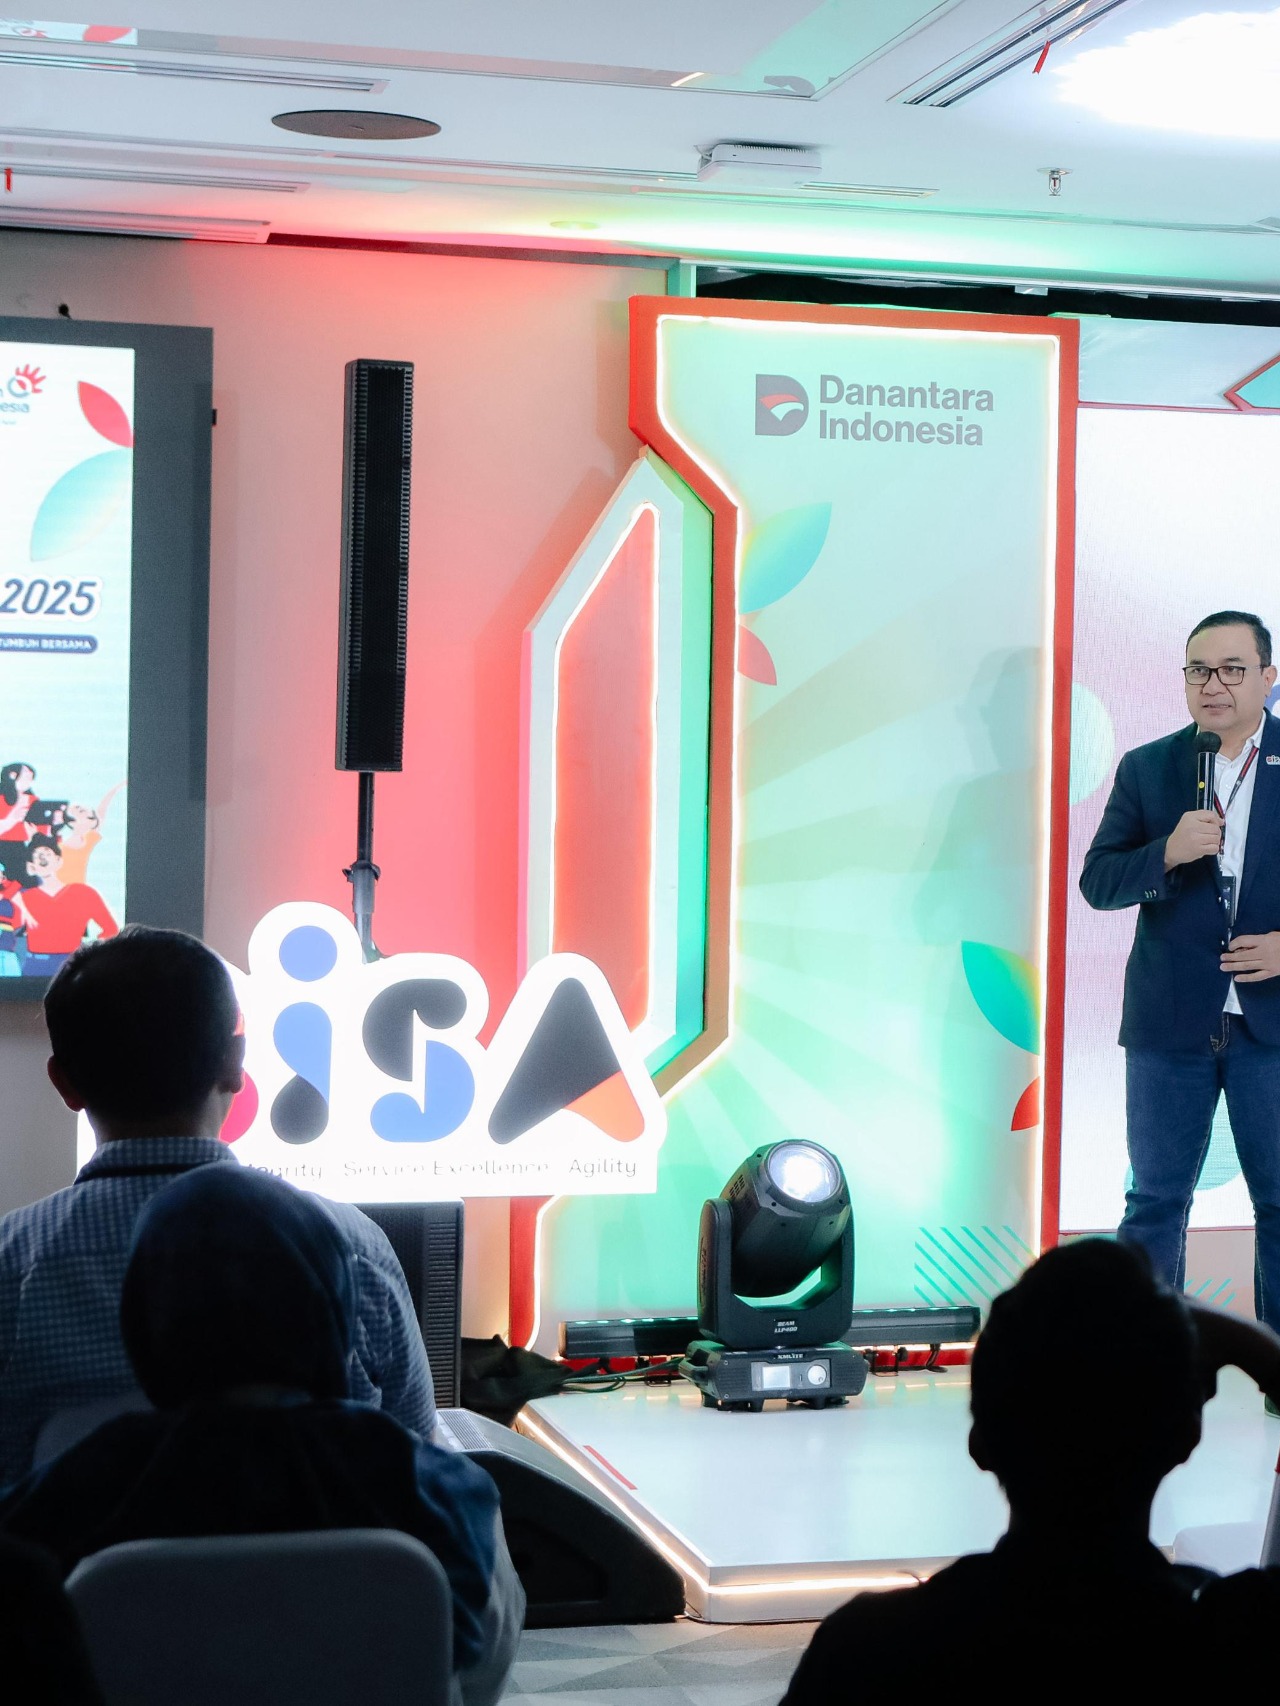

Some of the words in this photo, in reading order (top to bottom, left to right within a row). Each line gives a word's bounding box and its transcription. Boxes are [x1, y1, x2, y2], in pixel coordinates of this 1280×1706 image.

[819, 374, 994, 411] Danantara
[819, 410, 983, 446] Indonesia
[0, 578, 97, 616] 2025
[569, 1158, 637, 1177] Agility
